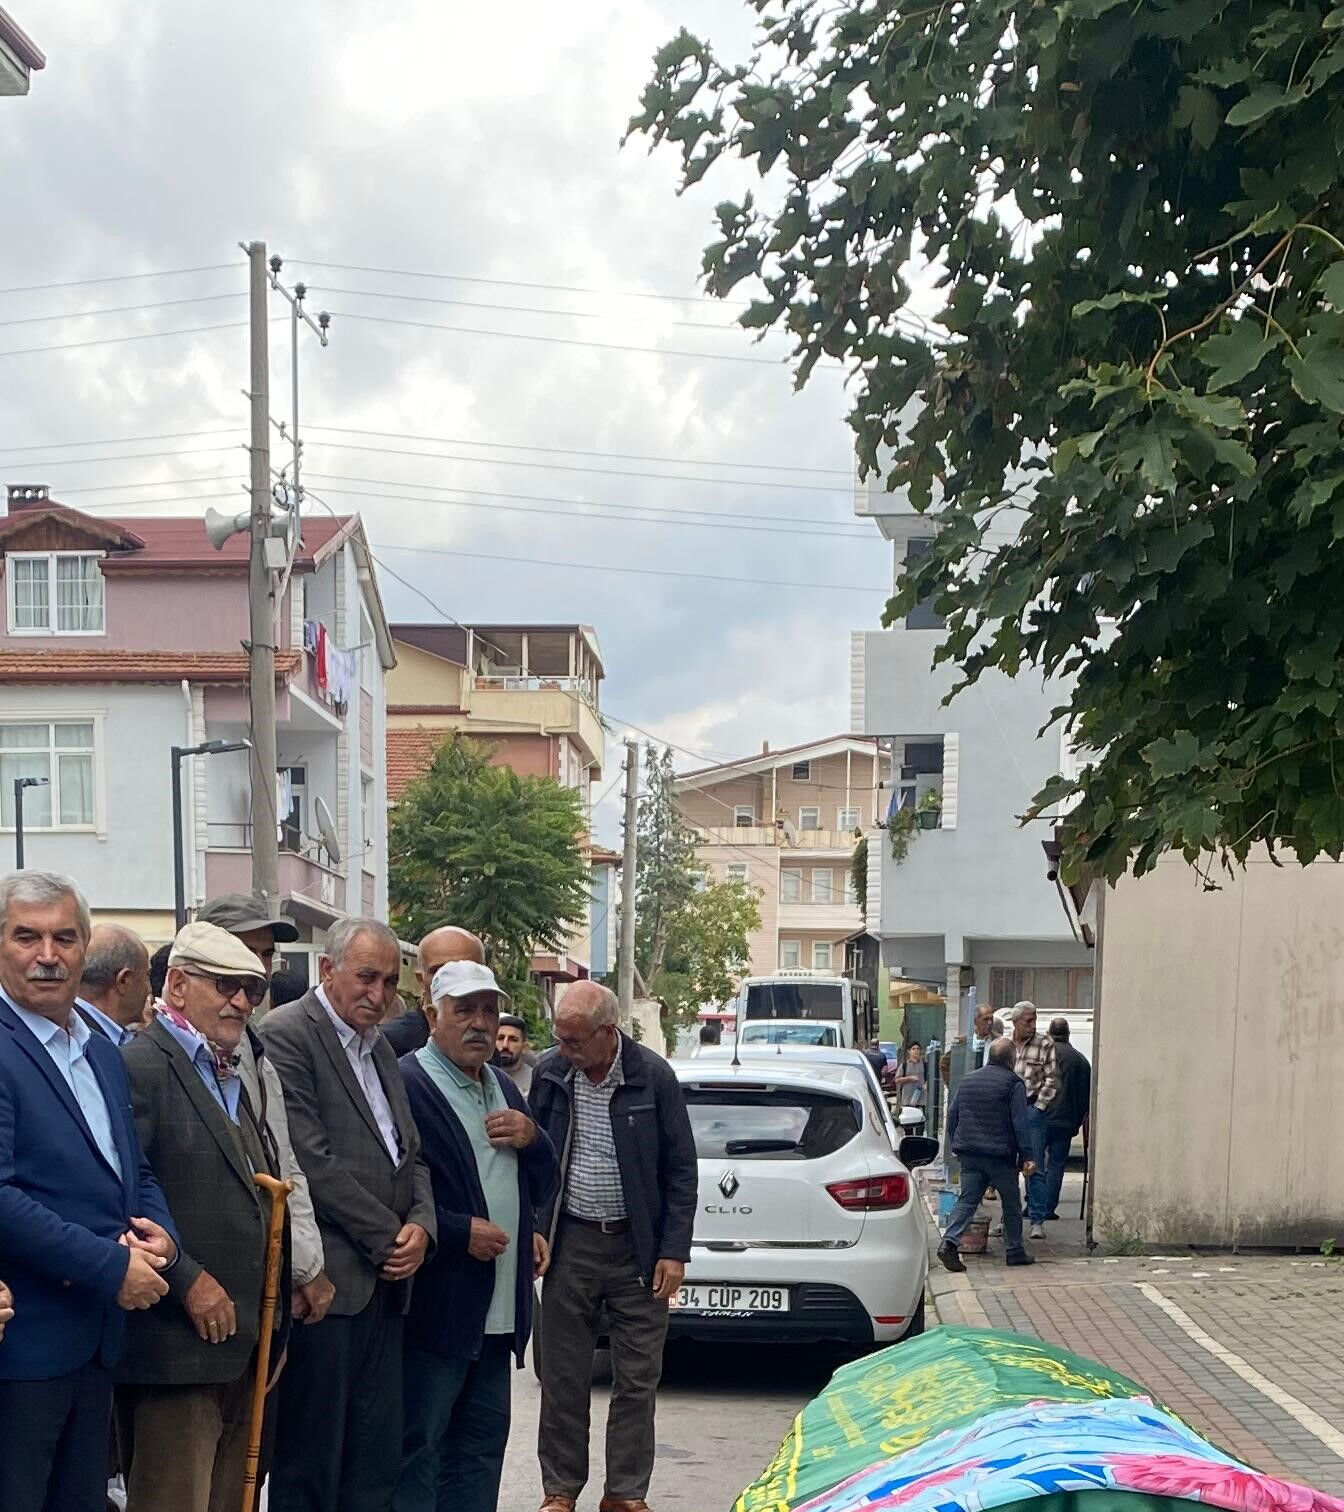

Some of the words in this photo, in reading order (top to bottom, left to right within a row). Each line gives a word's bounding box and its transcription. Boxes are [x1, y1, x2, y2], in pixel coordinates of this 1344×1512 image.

[704, 1205, 753, 1215] CLIO
[677, 1287, 700, 1307] 34
[708, 1288, 742, 1308] CUP
[748, 1289, 783, 1309] 209
